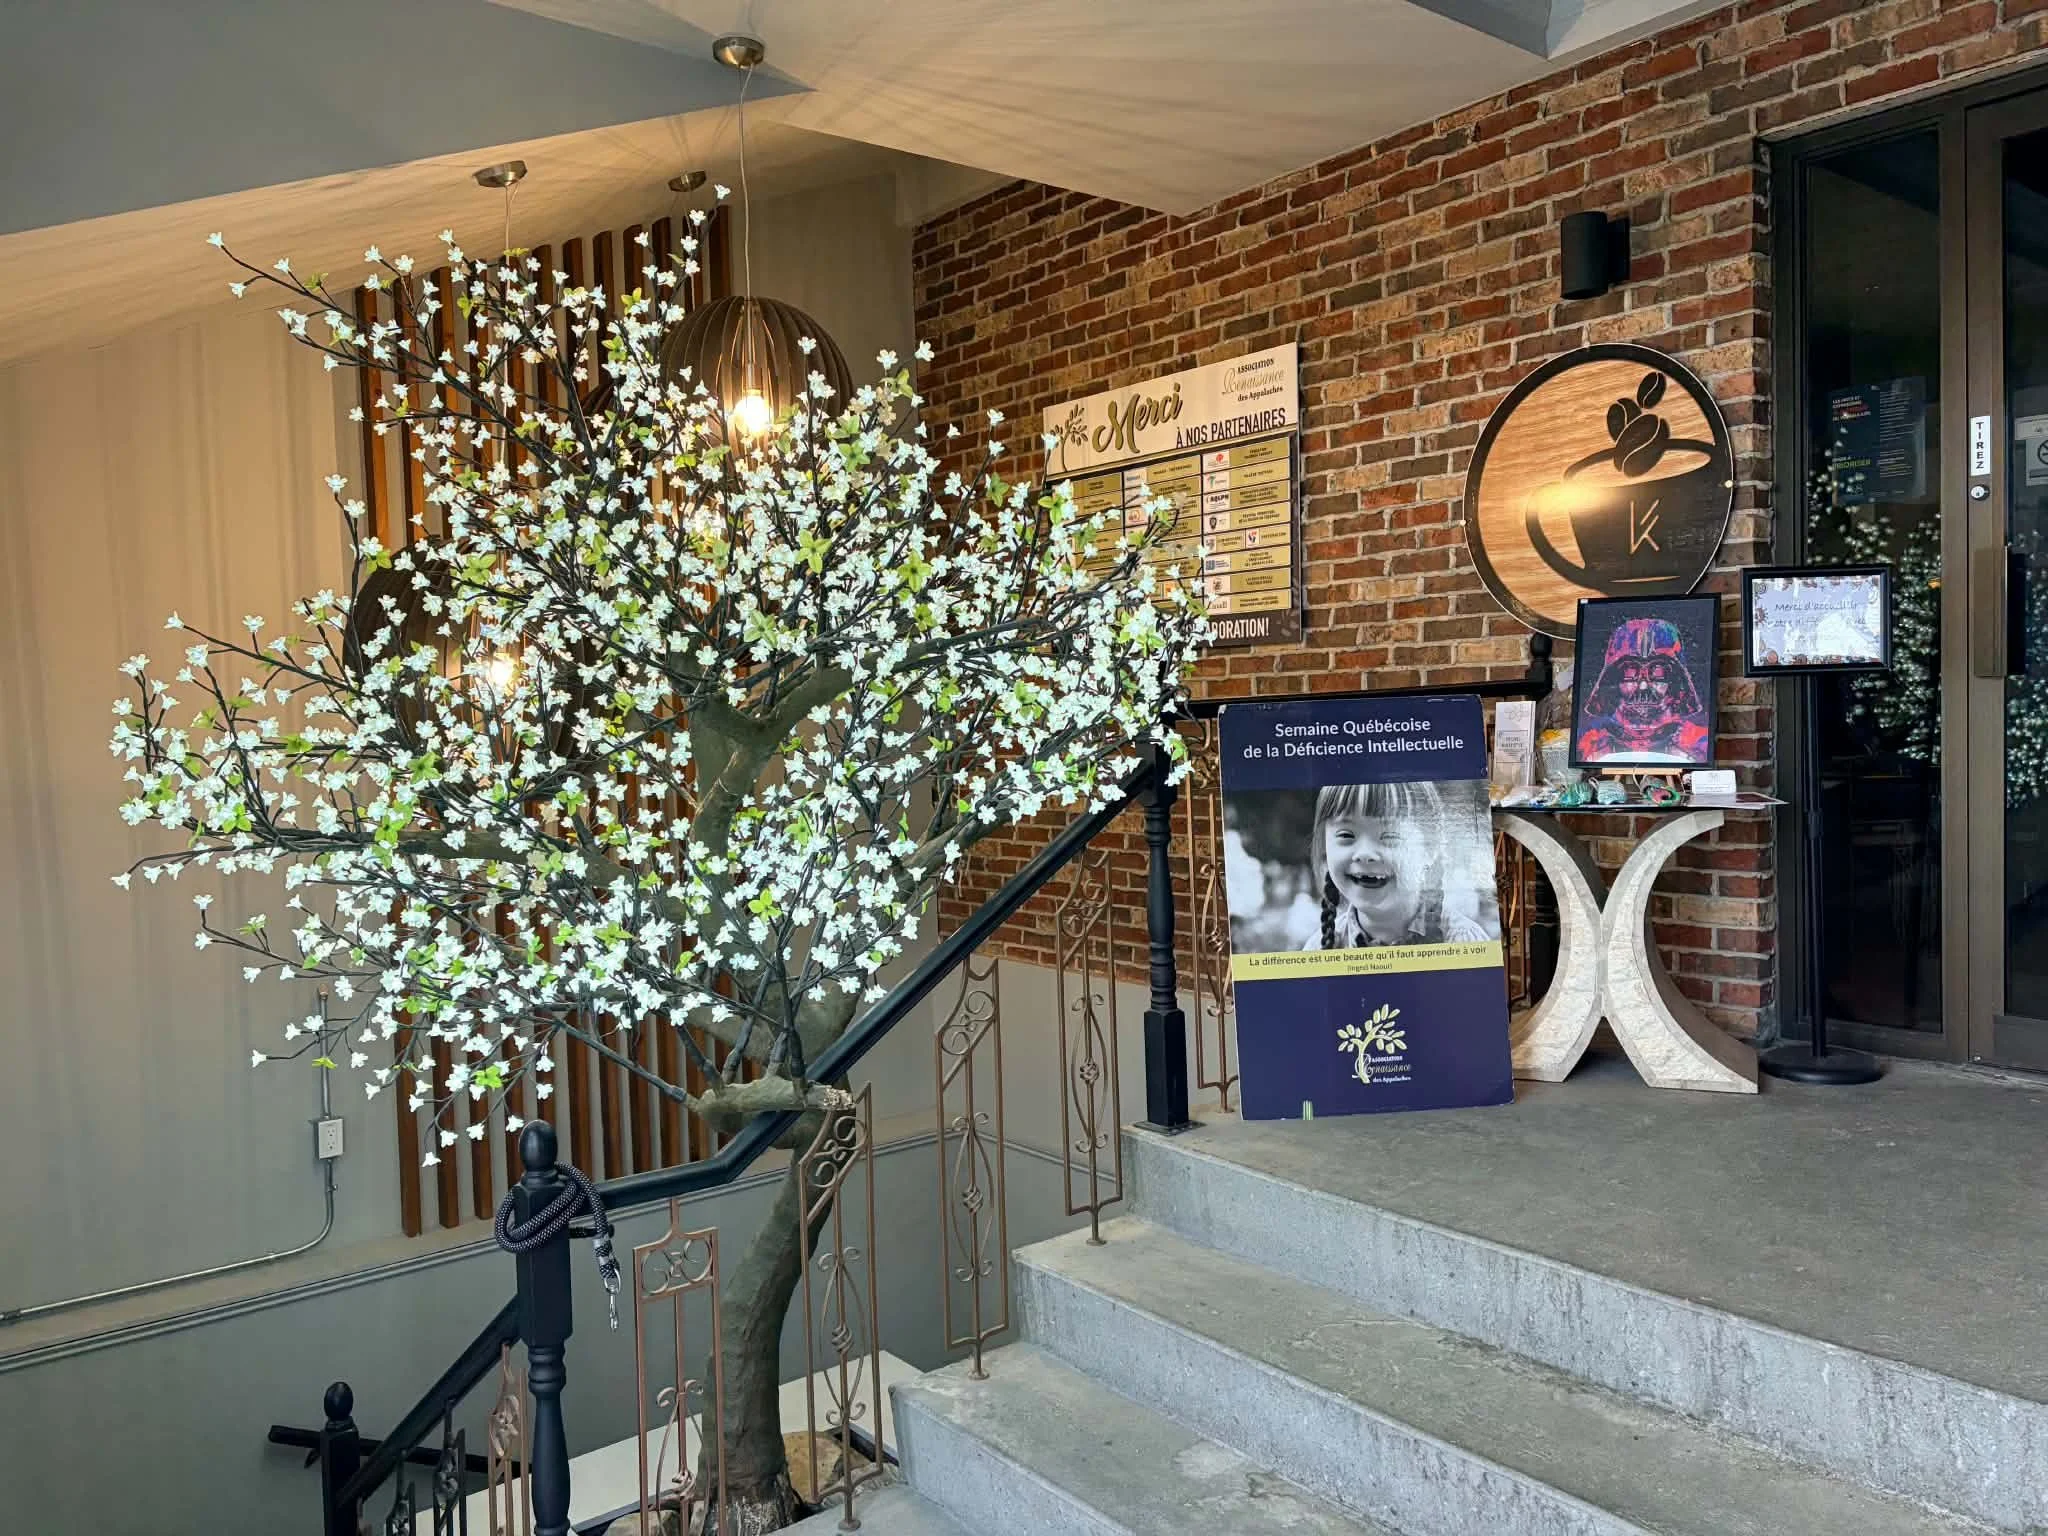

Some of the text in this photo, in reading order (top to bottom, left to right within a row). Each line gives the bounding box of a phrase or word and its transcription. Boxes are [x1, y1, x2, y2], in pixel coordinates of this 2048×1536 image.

[1092, 382, 1183, 454] Merci
[1176, 407, 1286, 449] À NOS PARTENAIRES
[1975, 421, 1985, 470] TIREZ
[1775, 602, 1802, 611] Merci
[1274, 717, 1431, 738] Semaine Québécoise
[1243, 735, 1464, 759] de la Déficience Intellectuelle
[1249, 945, 1487, 966] La différence est une beauté qu'il faut apprendre à voir
